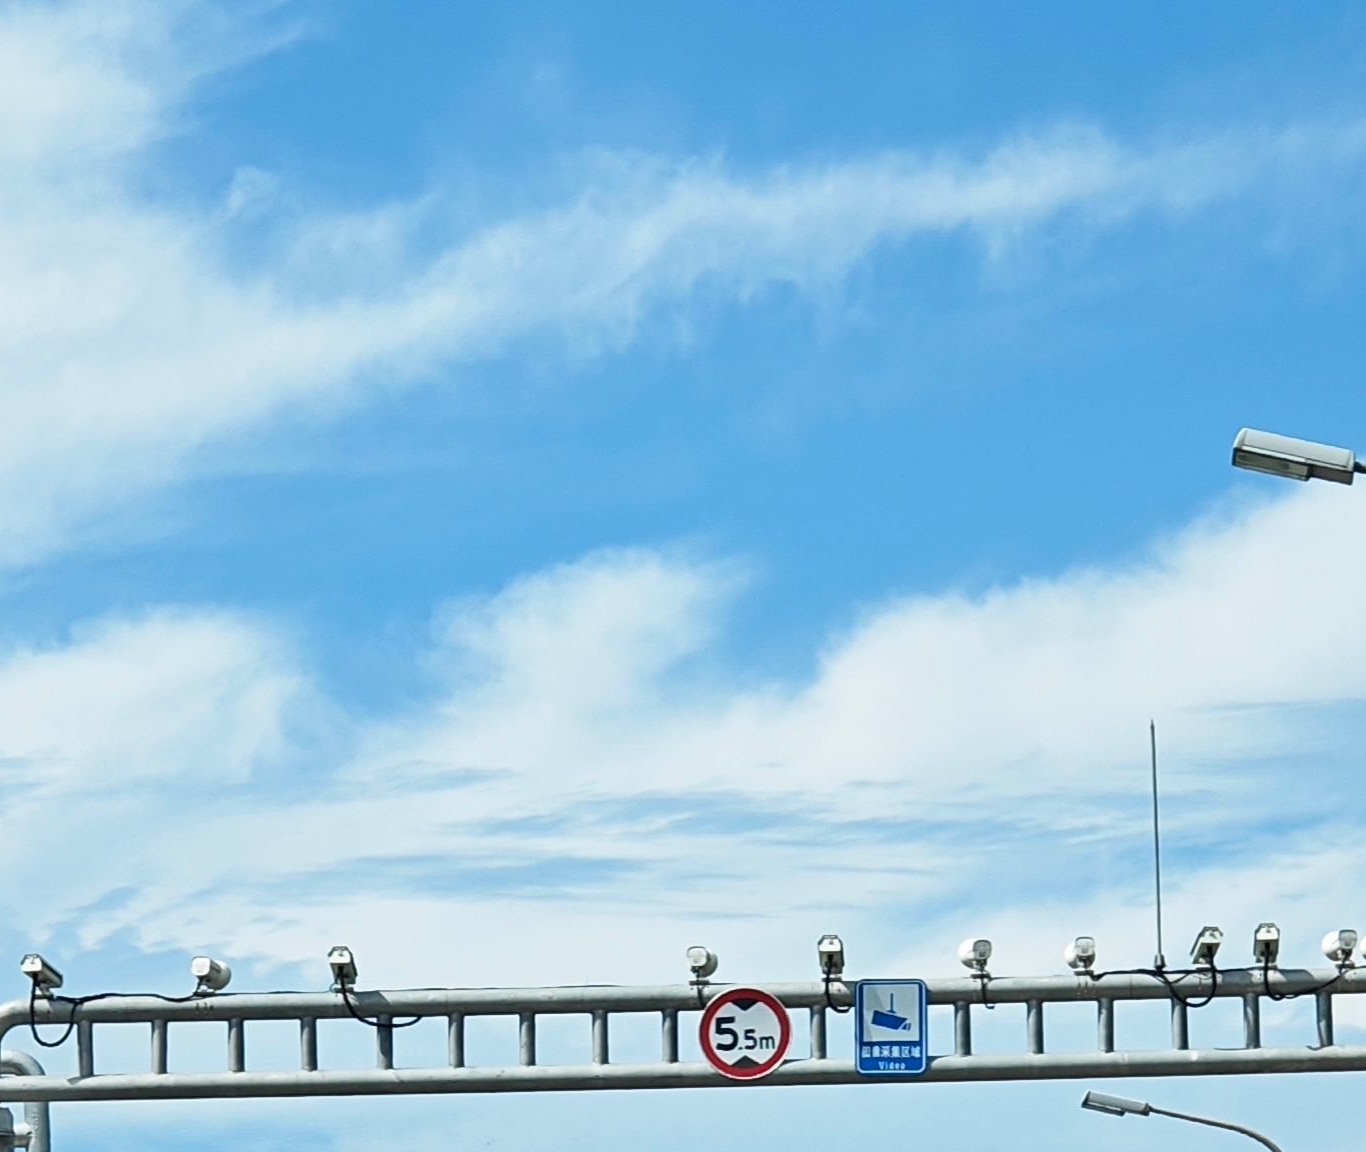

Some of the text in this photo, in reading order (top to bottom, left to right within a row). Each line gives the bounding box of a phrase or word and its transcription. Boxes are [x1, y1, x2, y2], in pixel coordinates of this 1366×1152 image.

[715, 1016, 775, 1051] 5.5m
[861, 1045, 921, 1058] 图像采集区域
[878, 1061, 906, 1070] Video
